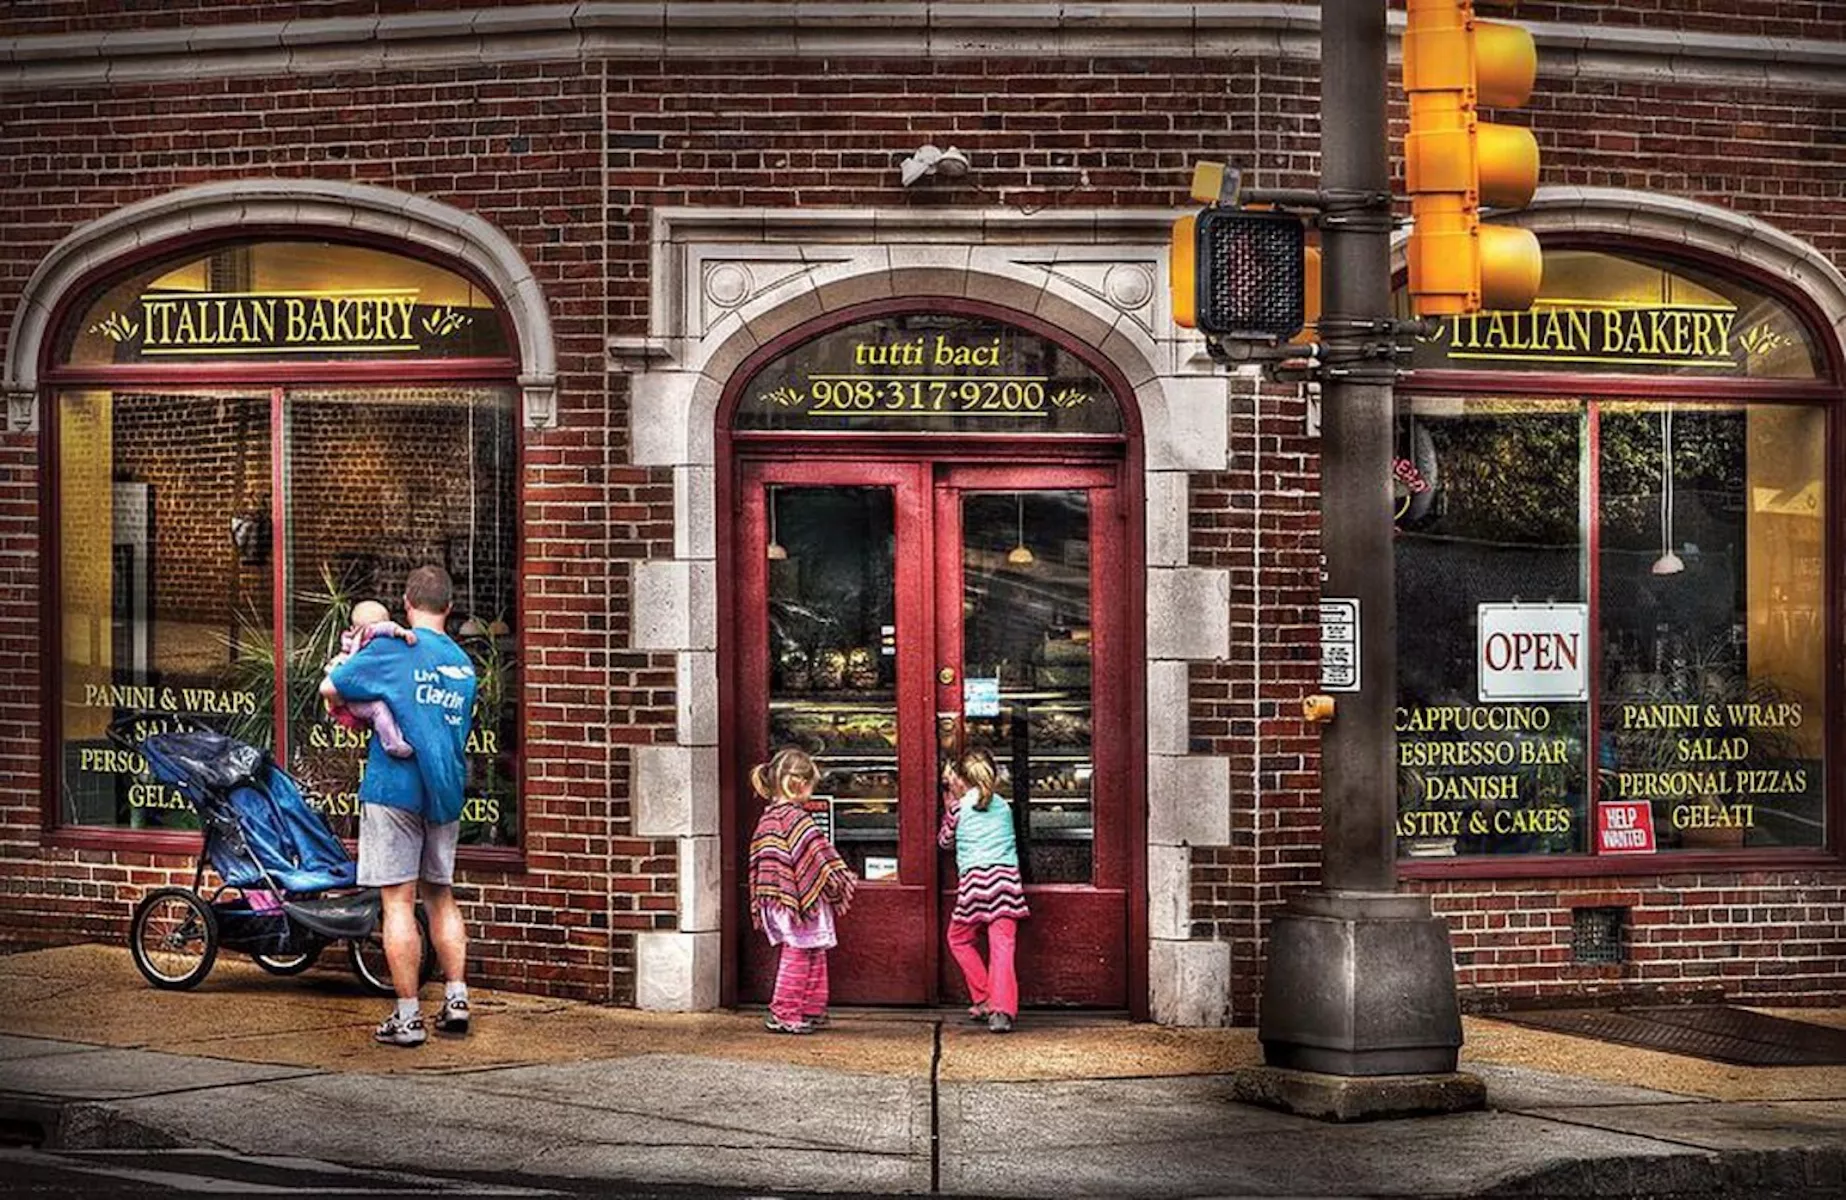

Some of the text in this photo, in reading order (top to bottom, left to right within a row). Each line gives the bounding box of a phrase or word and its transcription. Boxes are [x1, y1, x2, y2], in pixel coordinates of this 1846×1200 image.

[142, 297, 417, 345] ITALIAN BAKERY
[1450, 306, 1736, 356] ITALIAN BAKERY
[856, 335, 1000, 367] tutti baci
[1485, 631, 1580, 672] OPEN
[85, 683, 257, 715] PANINI & WRAPS
[1394, 706, 1550, 732] CAPPUCCINO
[1623, 702, 1803, 729] PANINI & WRAPS
[309, 723, 330, 748] &
[1400, 740, 1568, 766] ESPRESSO BAR
[1677, 737, 1749, 762] SALAD
[1425, 775, 1519, 801] DANISH
[1619, 769, 1806, 797] PERSONAL PIZZAS
[1395, 808, 1571, 837] ASTRY & CAKES
[1605, 807, 1637, 828] HELP
[1672, 804, 1755, 829] GELATI
[1601, 828, 1647, 848] WANTED
